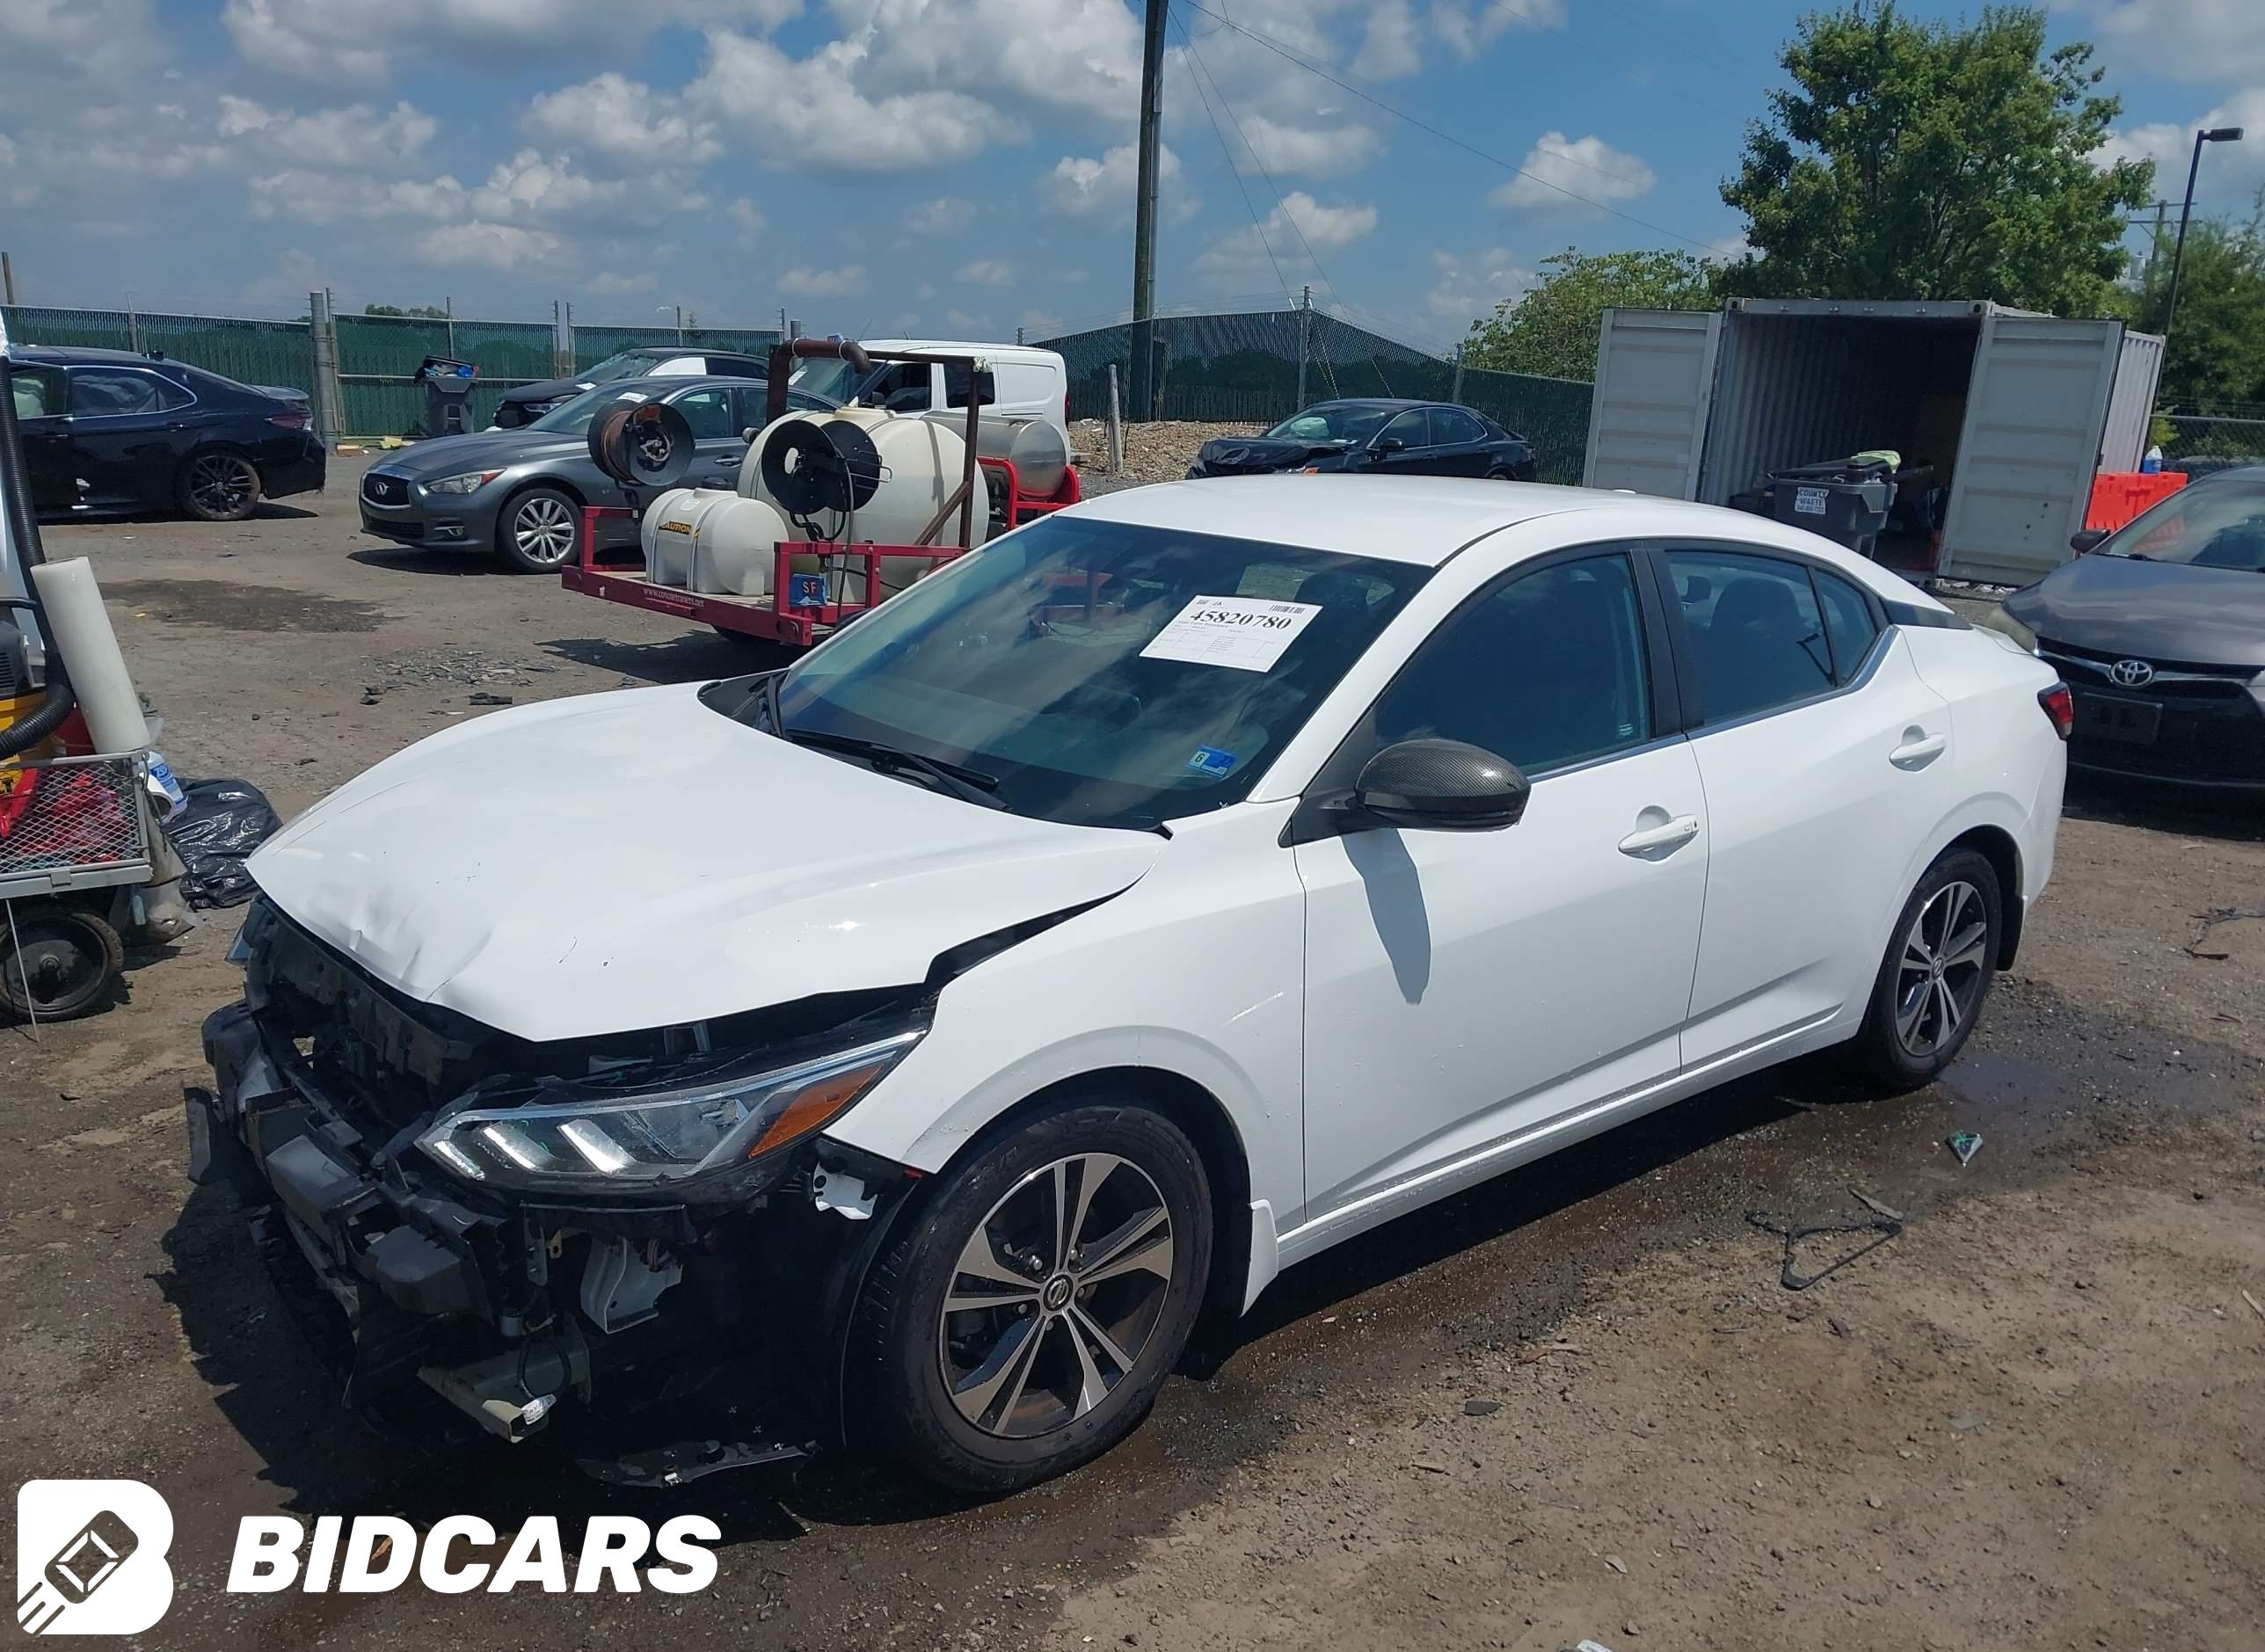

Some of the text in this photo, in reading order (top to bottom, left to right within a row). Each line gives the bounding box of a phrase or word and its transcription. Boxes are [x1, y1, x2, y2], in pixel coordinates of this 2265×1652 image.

[1799, 498, 1824, 506] WASTE
[1190, 609, 1293, 630] 45820780
[1194, 753, 1205, 763] 6
